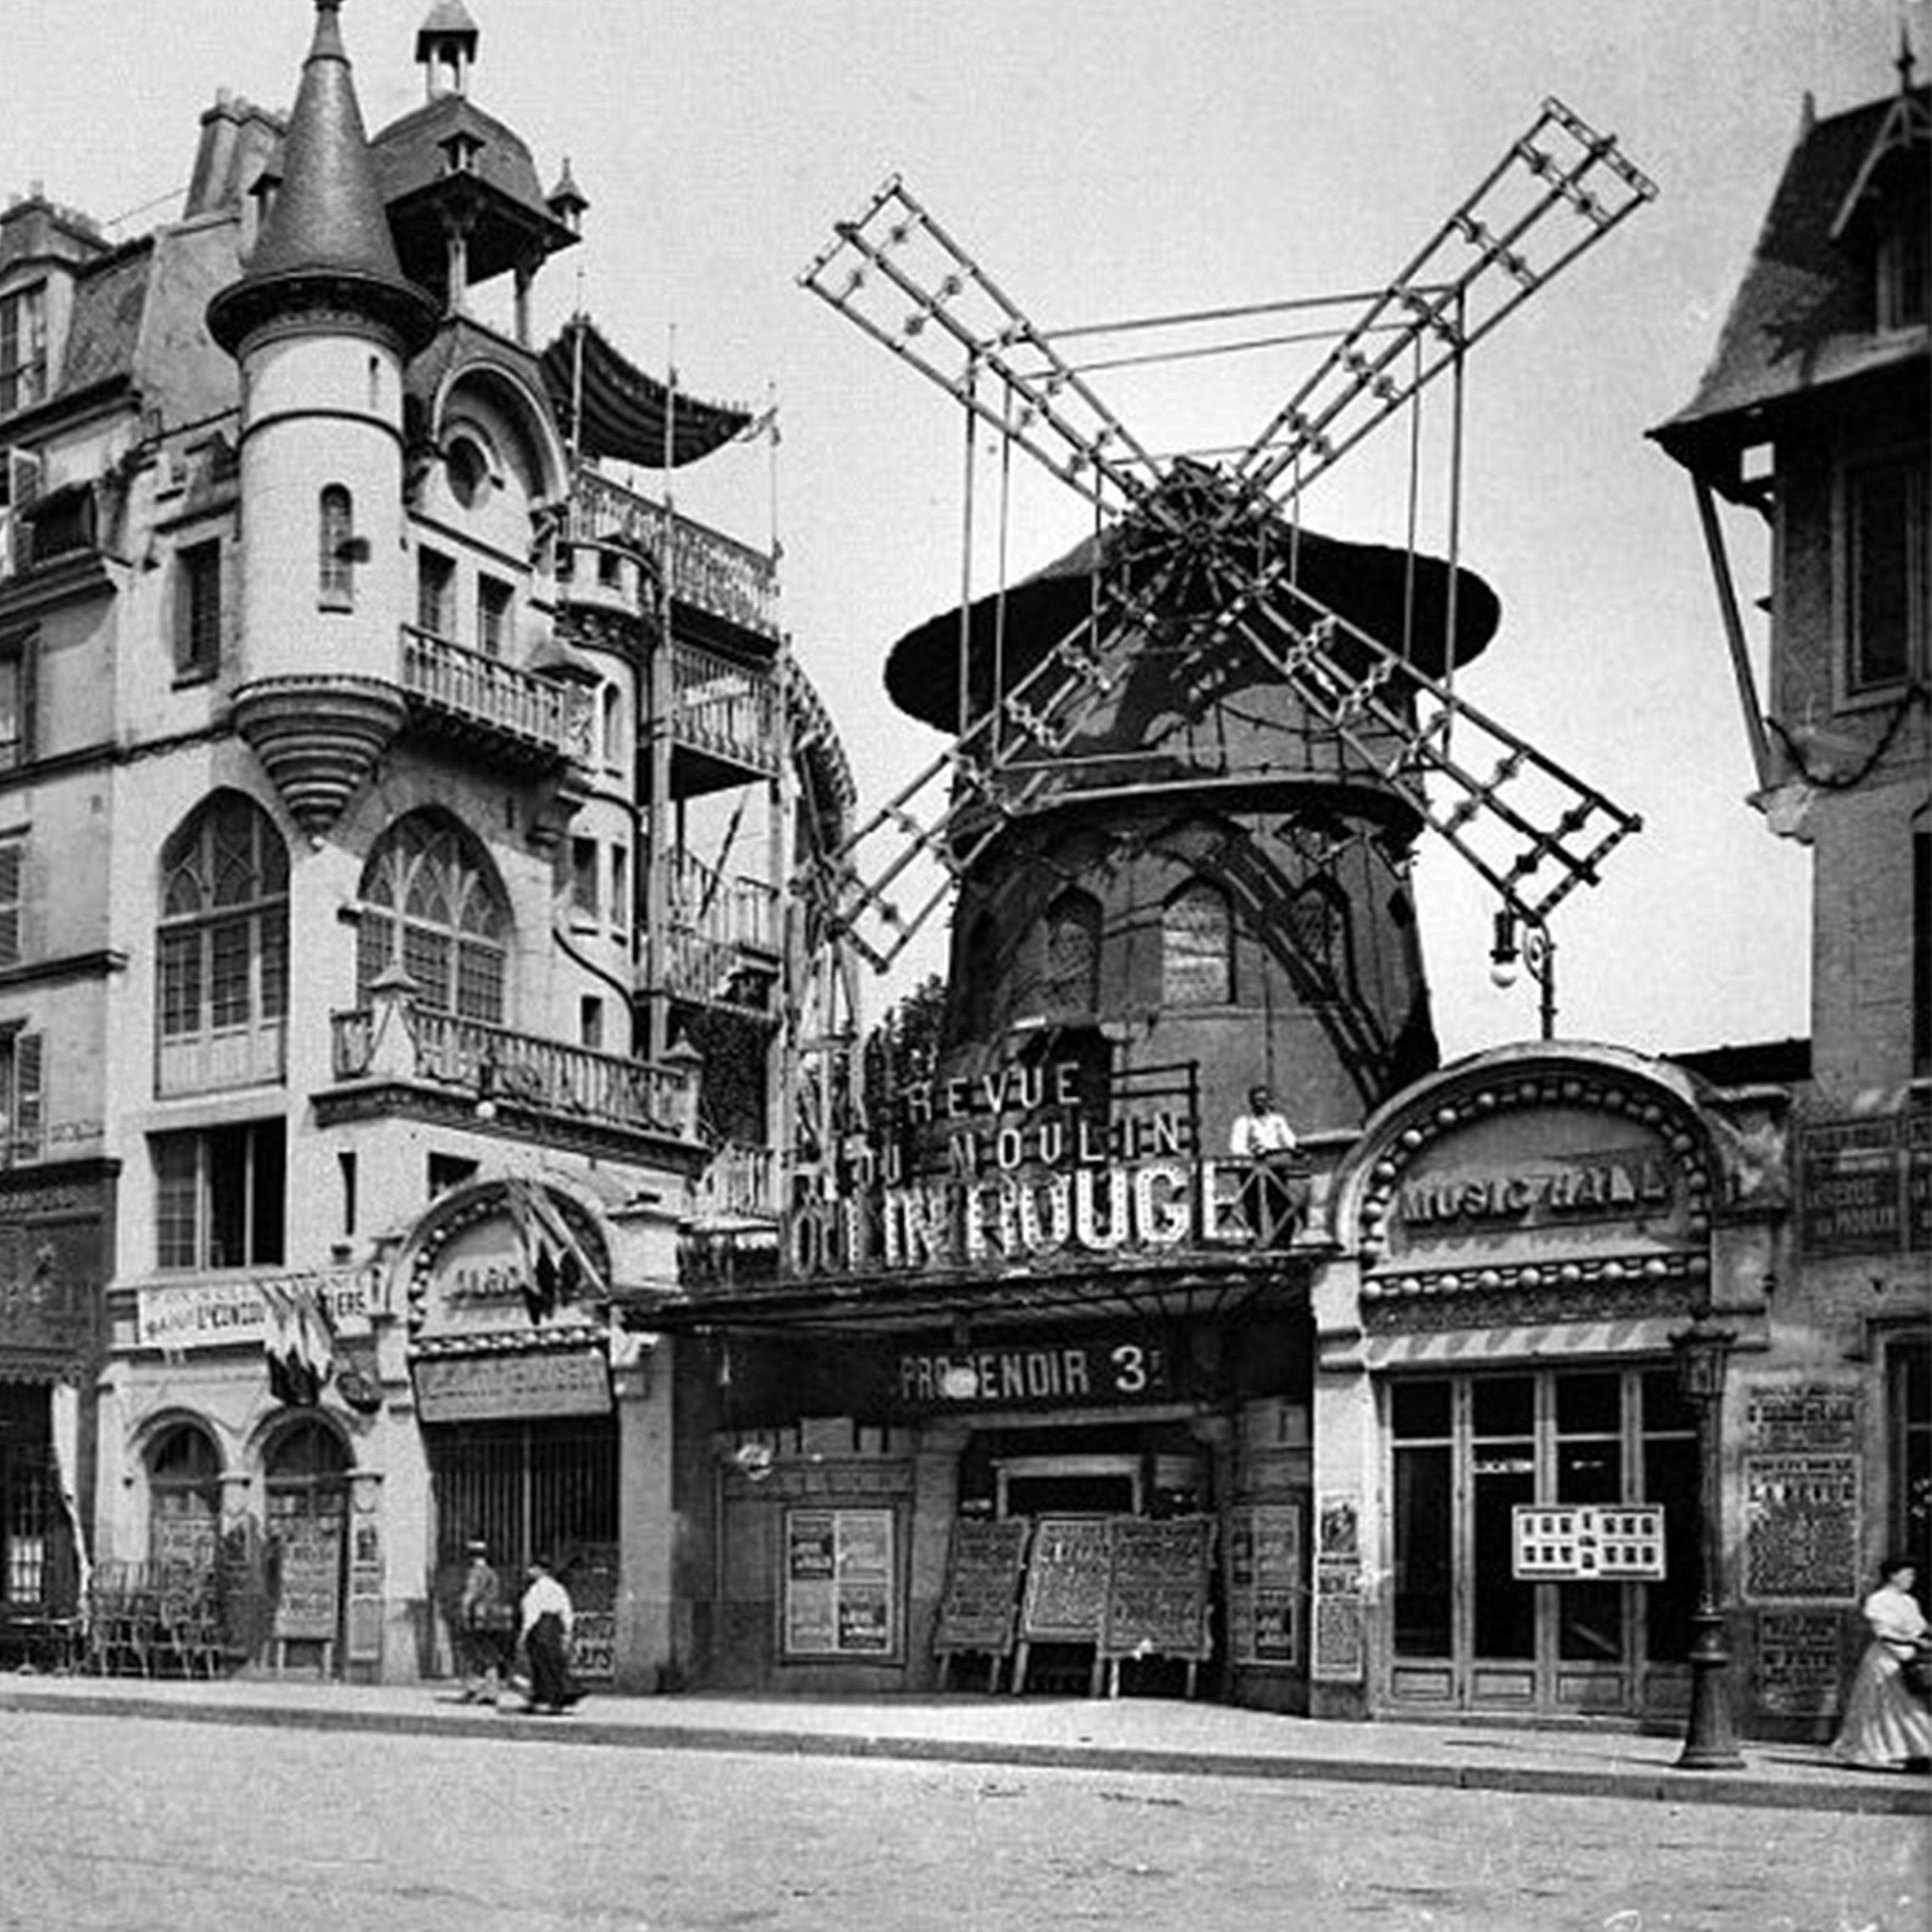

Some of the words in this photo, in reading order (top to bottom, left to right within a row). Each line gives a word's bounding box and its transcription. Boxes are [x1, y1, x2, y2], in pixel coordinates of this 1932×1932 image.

[907, 1061, 1081, 1122] REVUE
[949, 1113, 1180, 1180] MOULIN
[968, 1159, 1256, 1260] ROUGE
[903, 1350, 1090, 1399] PROENOIR
